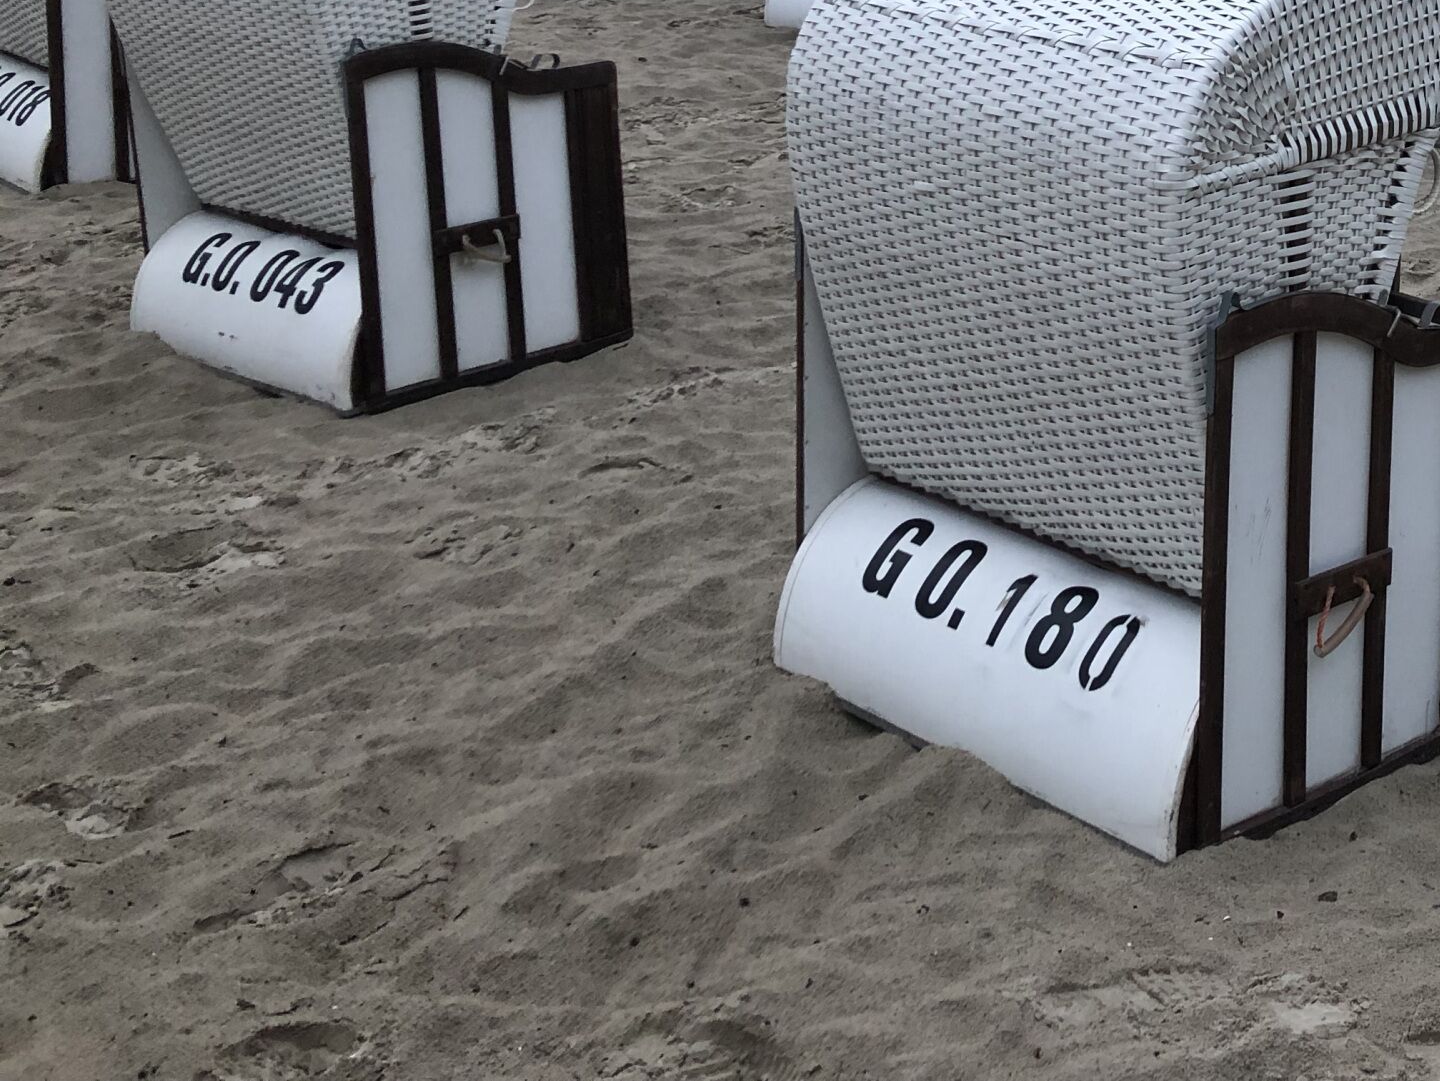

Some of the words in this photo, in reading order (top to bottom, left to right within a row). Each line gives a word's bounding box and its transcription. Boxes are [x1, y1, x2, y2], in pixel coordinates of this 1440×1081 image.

[0, 80, 51, 127] 018
[182, 232, 261, 295] G.O.
[250, 249, 345, 315] 043
[862, 518, 988, 630] GO.
[985, 574, 1146, 692] 180
